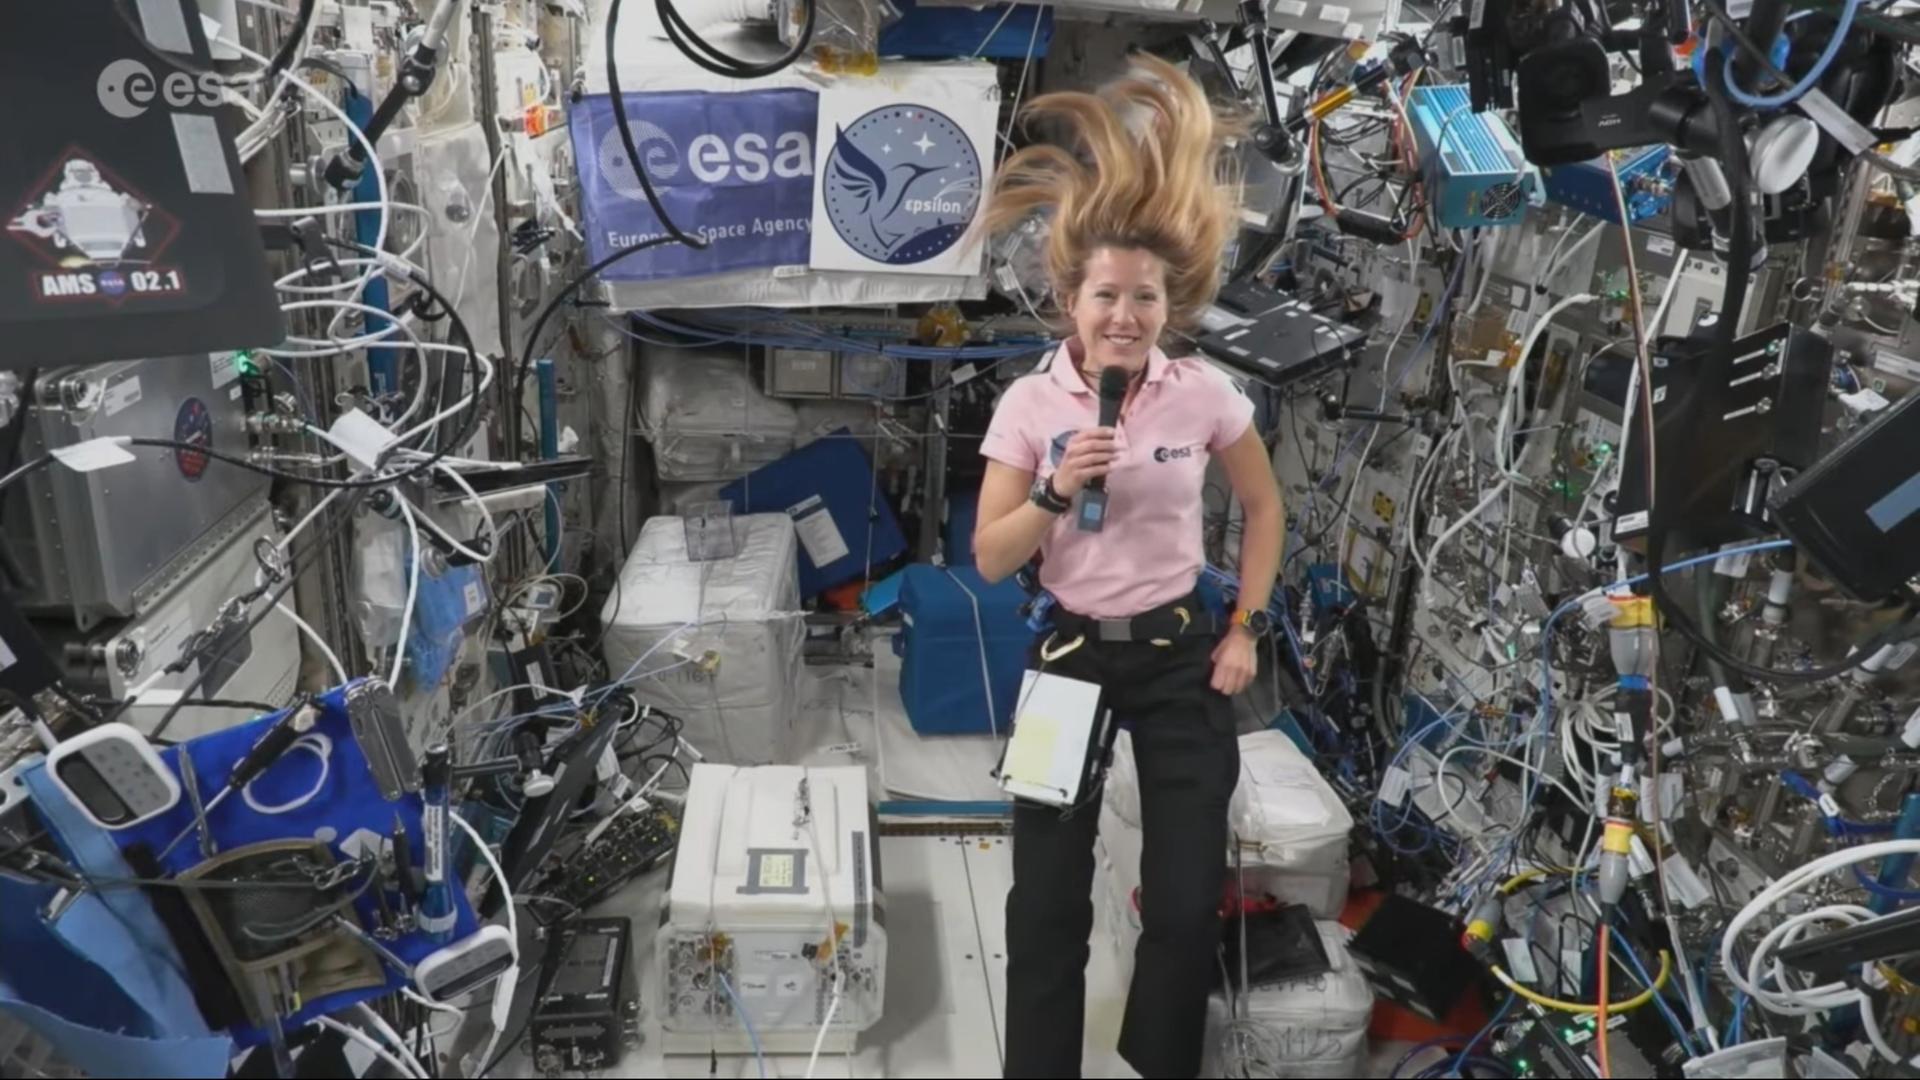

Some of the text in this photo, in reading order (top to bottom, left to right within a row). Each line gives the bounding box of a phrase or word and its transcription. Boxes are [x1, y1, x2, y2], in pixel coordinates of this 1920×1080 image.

[688, 131, 813, 183] esa
[697, 223, 747, 246] Space
[41, 274, 96, 296] AMS
[130, 271, 181, 292] 02.1
